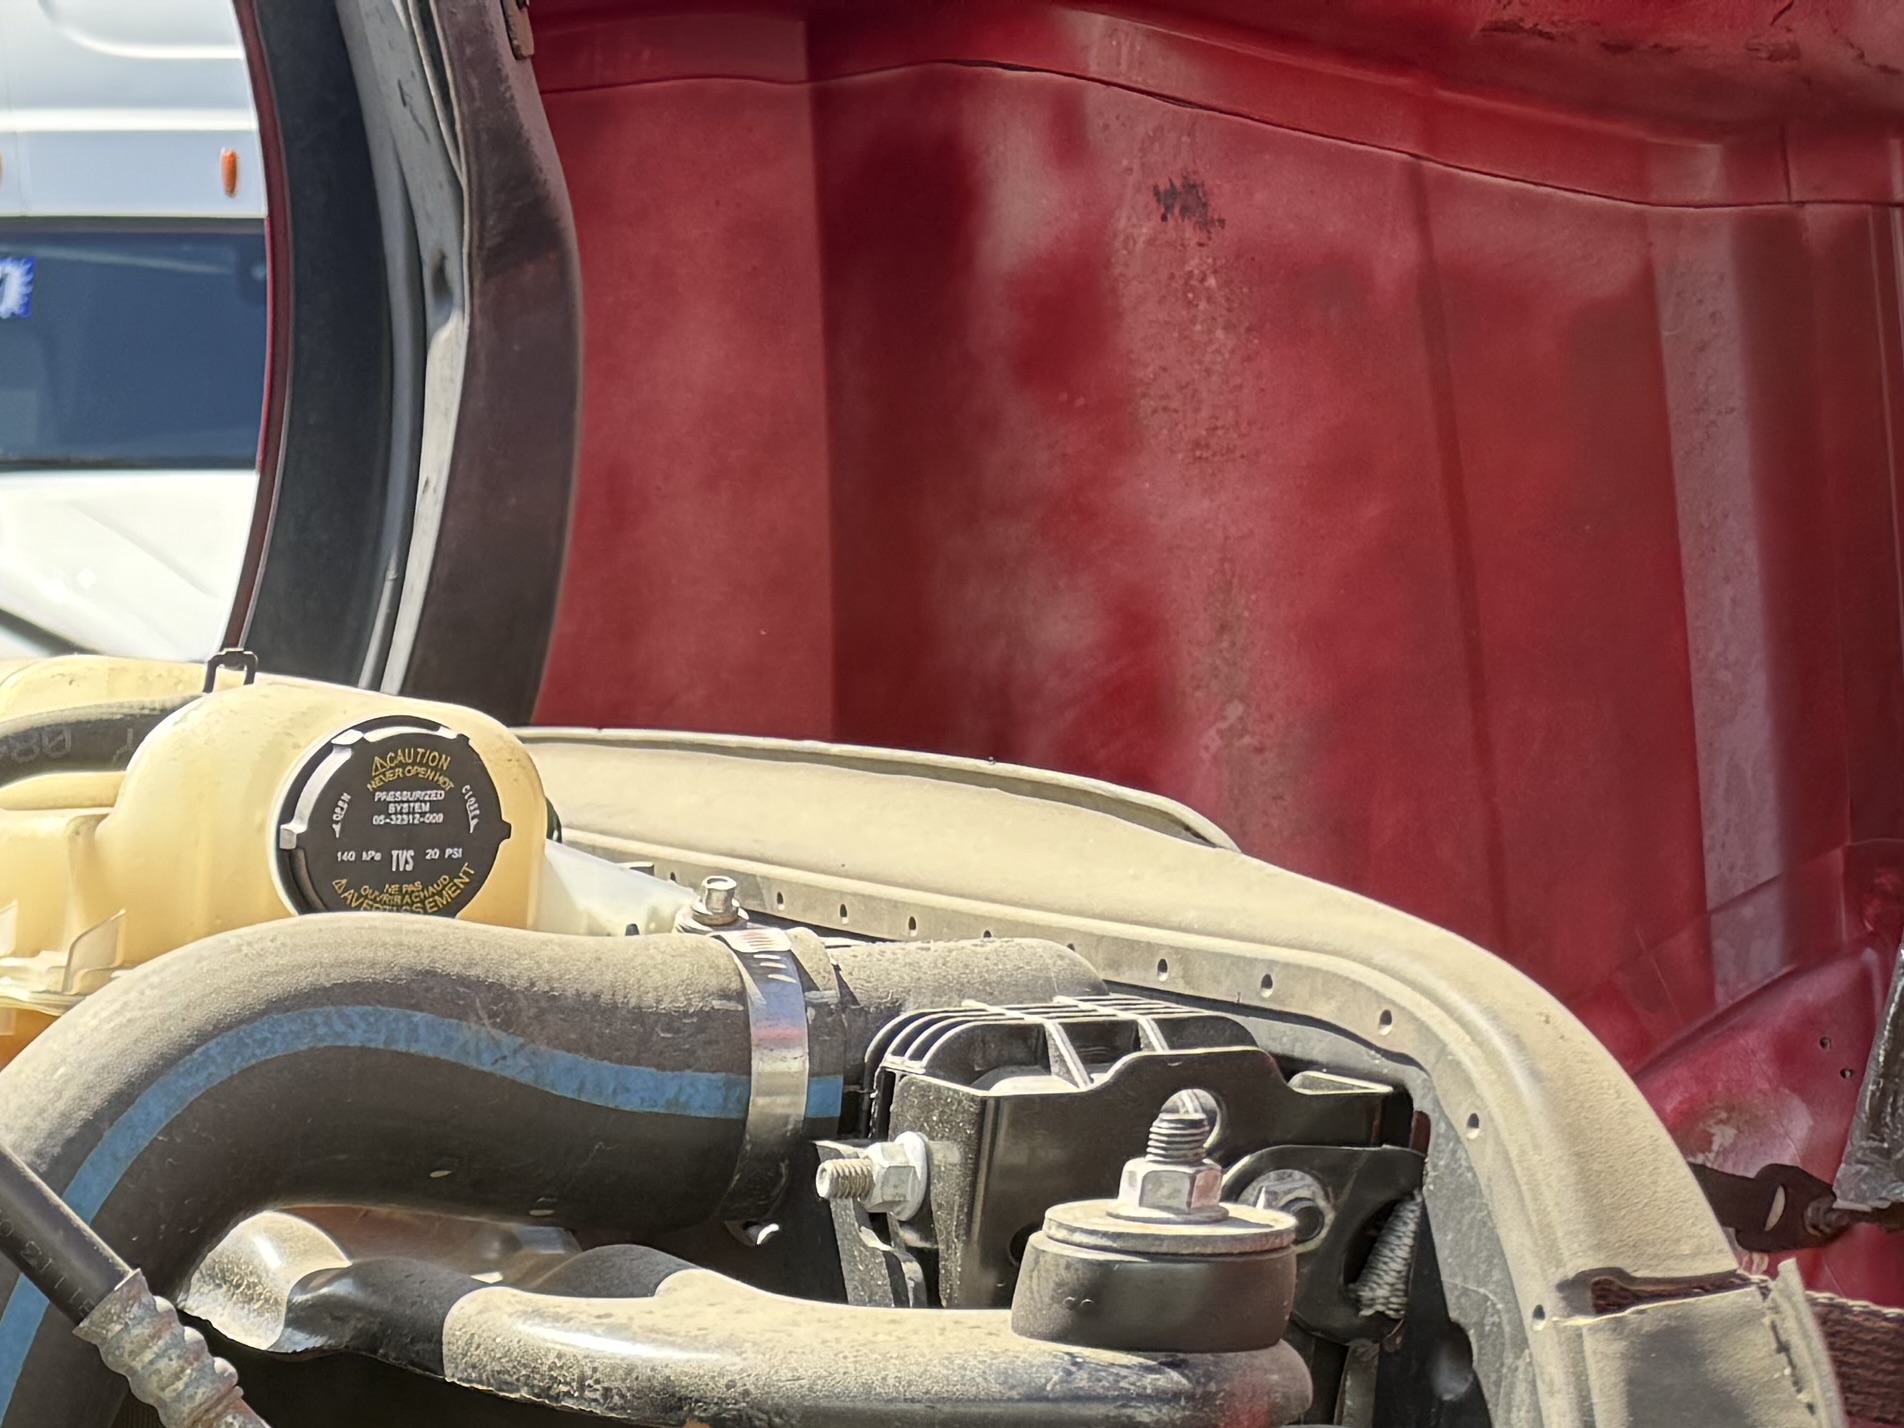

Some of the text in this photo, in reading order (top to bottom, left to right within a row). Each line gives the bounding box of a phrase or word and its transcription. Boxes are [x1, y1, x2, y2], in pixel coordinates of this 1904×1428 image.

[386, 748, 451, 771] CAUTION
[366, 766, 403, 792] NEVER
[405, 765, 433, 782] OPEN
[374, 789, 445, 802] PRESSURIZED
[388, 802, 431, 814] SYSTEM
[337, 851, 356, 862] 140
[391, 849, 415, 872] TVS
[425, 848, 463, 860] 20 PSI
[384, 881, 423, 894] NE PAS
[411, 874, 450, 901] CHAUD
